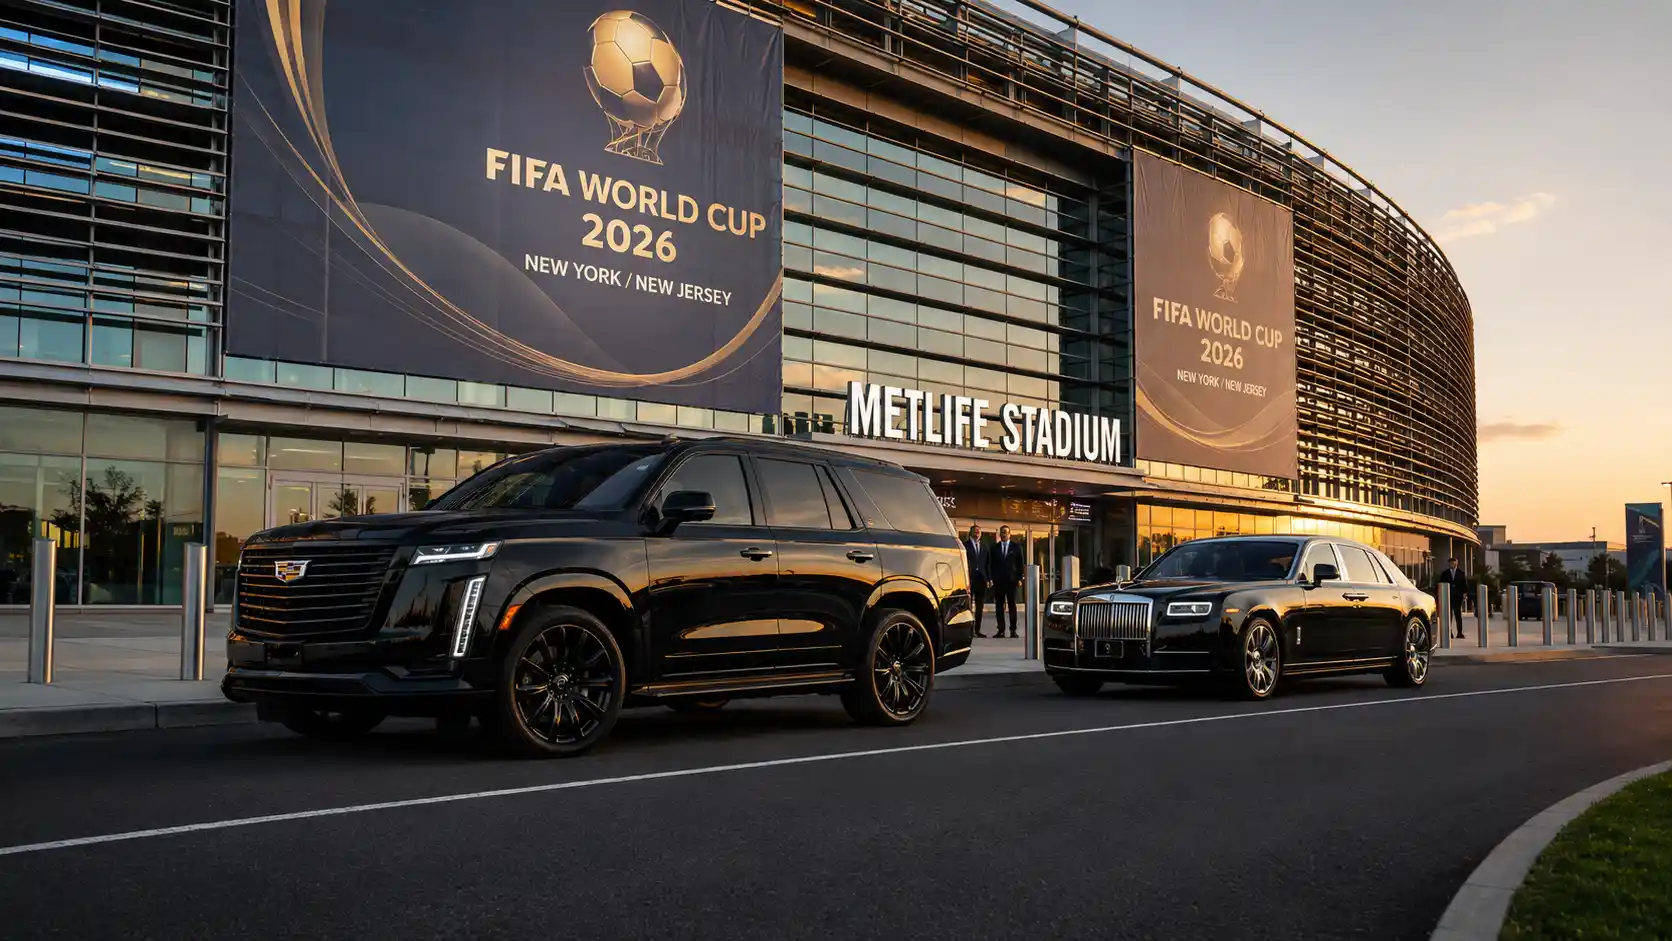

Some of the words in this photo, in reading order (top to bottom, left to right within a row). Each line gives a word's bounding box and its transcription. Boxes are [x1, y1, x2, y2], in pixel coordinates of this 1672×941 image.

[486, 147, 571, 197] FIFA
[577, 169, 699, 224] WORLD
[707, 202, 767, 239] CUP
[582, 213, 677, 263] 2026
[524, 253, 569, 276] NEW
[573, 262, 622, 287] YORK
[635, 275, 674, 296] NEW
[677, 282, 732, 306] JERSEY
[1153, 296, 1193, 328] FIFA
[1195, 307, 1252, 341] WORLD
[1255, 325, 1283, 349] CUP
[1200, 338, 1244, 370] 2026
[1177, 369, 1197, 383] NEW
[1199, 373, 1220, 388] YORK
[1225, 378, 1242, 393] NEW
[1243, 383, 1267, 398] JERSEY
[848, 381, 990, 448] METLIFE
[1001, 403, 1121, 463] STADIUM
